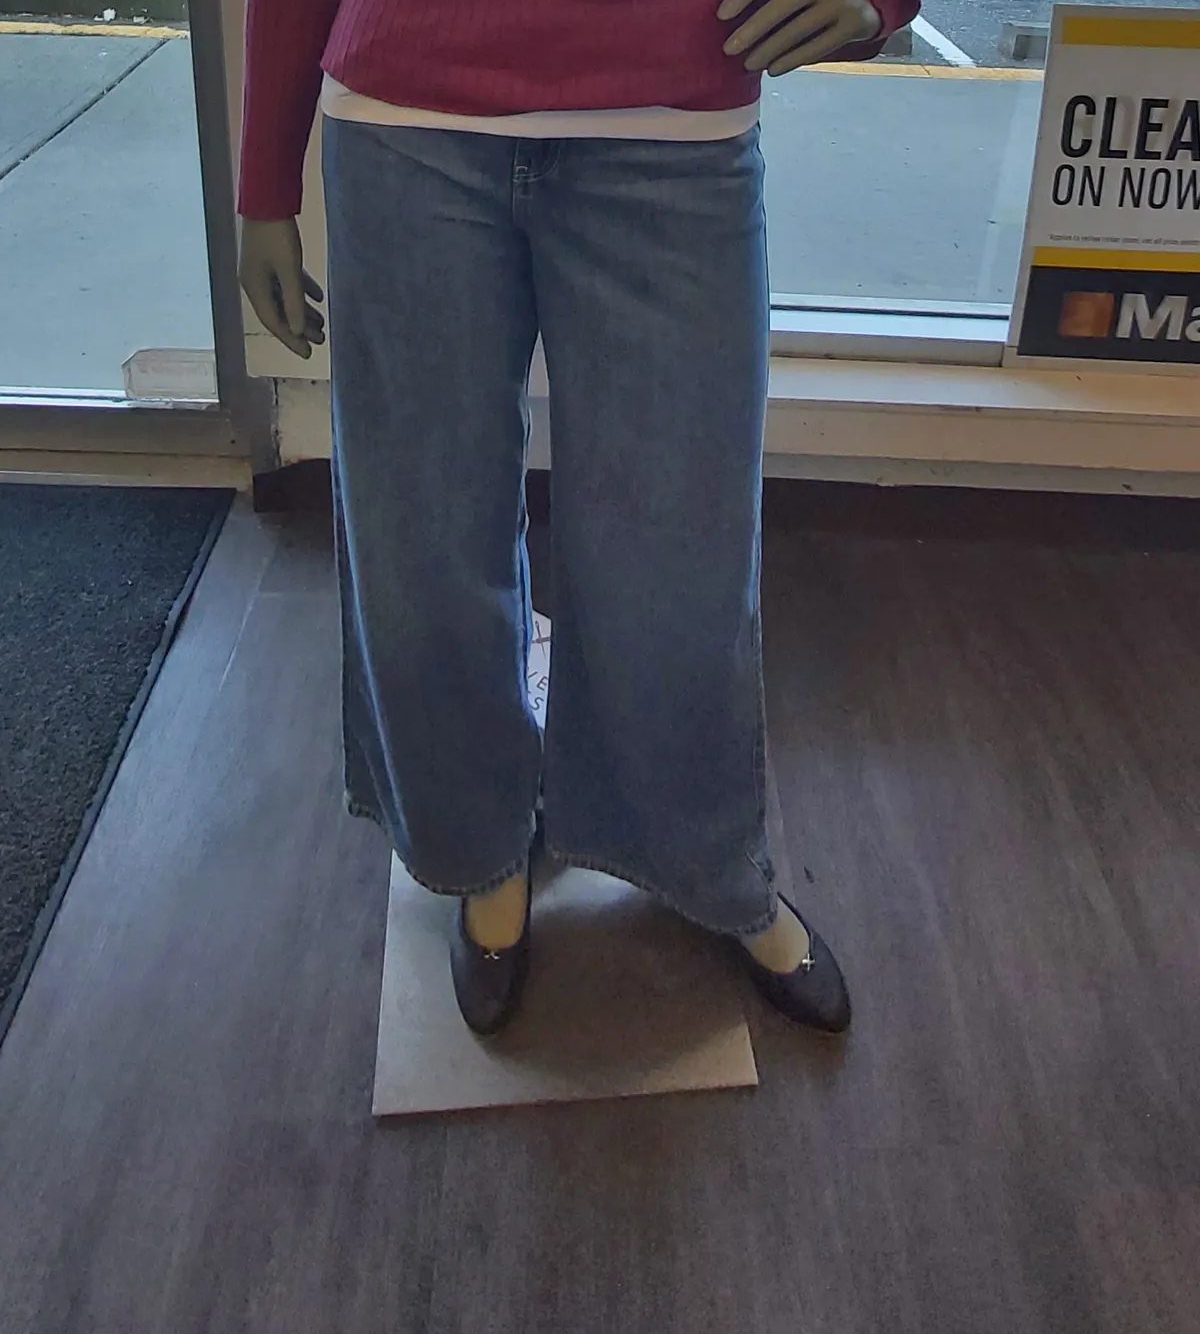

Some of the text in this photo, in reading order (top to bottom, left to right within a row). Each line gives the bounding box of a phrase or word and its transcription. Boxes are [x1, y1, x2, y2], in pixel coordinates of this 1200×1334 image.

[1061, 94, 1200, 162] CLEA
[1052, 164, 1200, 210] ON NOW
